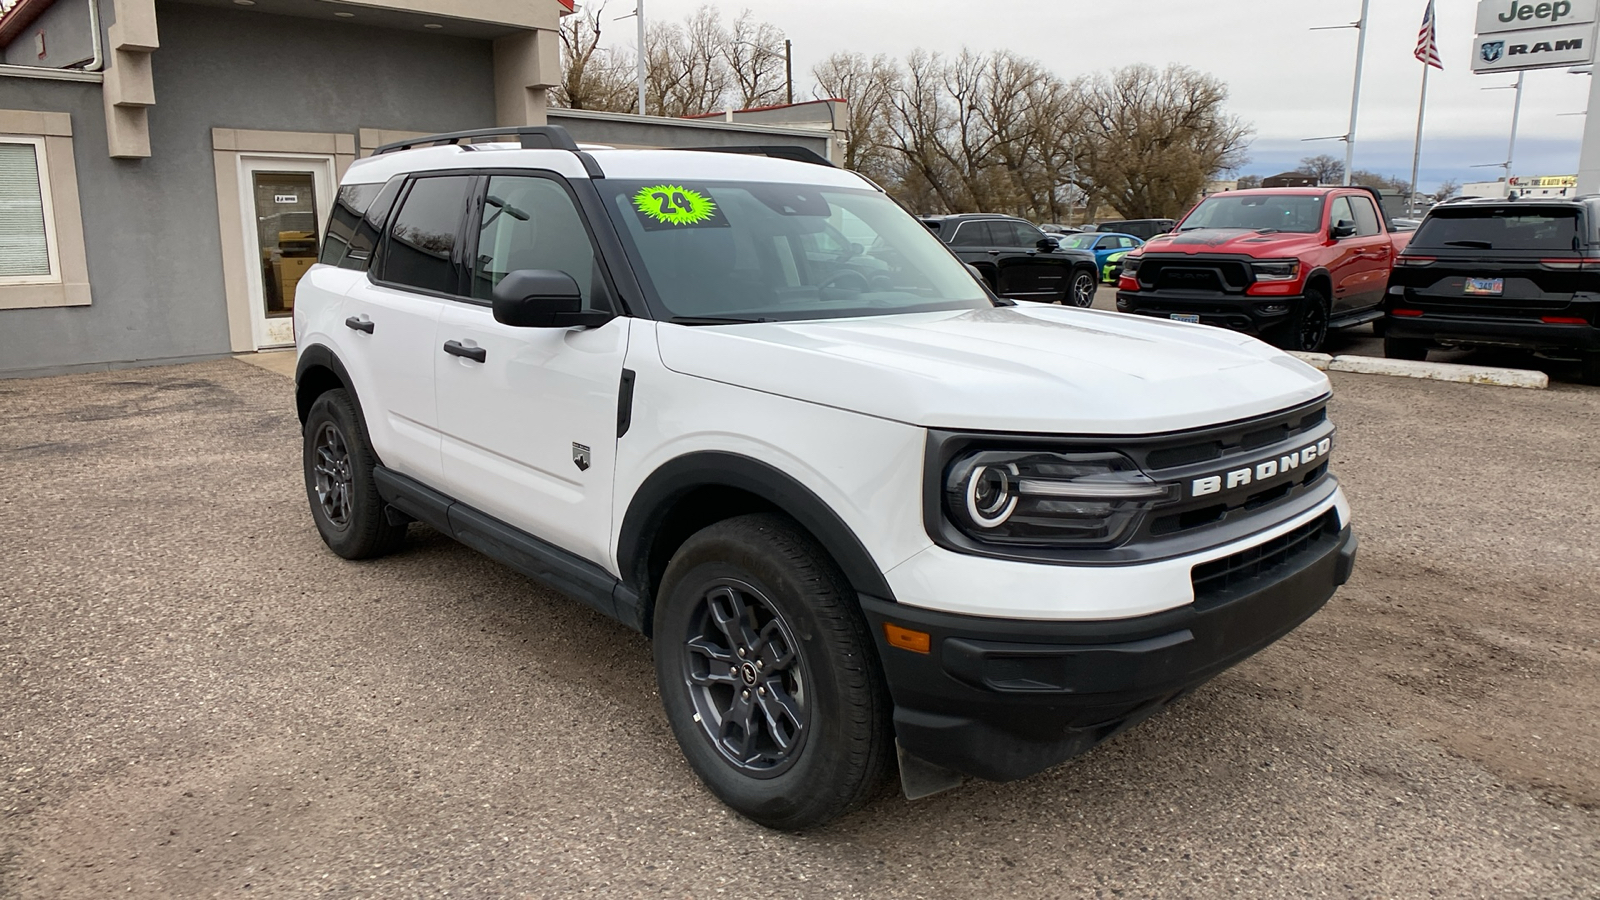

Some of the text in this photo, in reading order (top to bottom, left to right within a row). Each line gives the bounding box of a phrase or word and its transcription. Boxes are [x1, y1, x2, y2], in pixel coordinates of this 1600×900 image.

[1498, 0, 1572, 23] Jeep
[1508, 38, 1583, 56] RAM
[651, 192, 693, 214] 24
[1192, 437, 1331, 497] BRONCO
